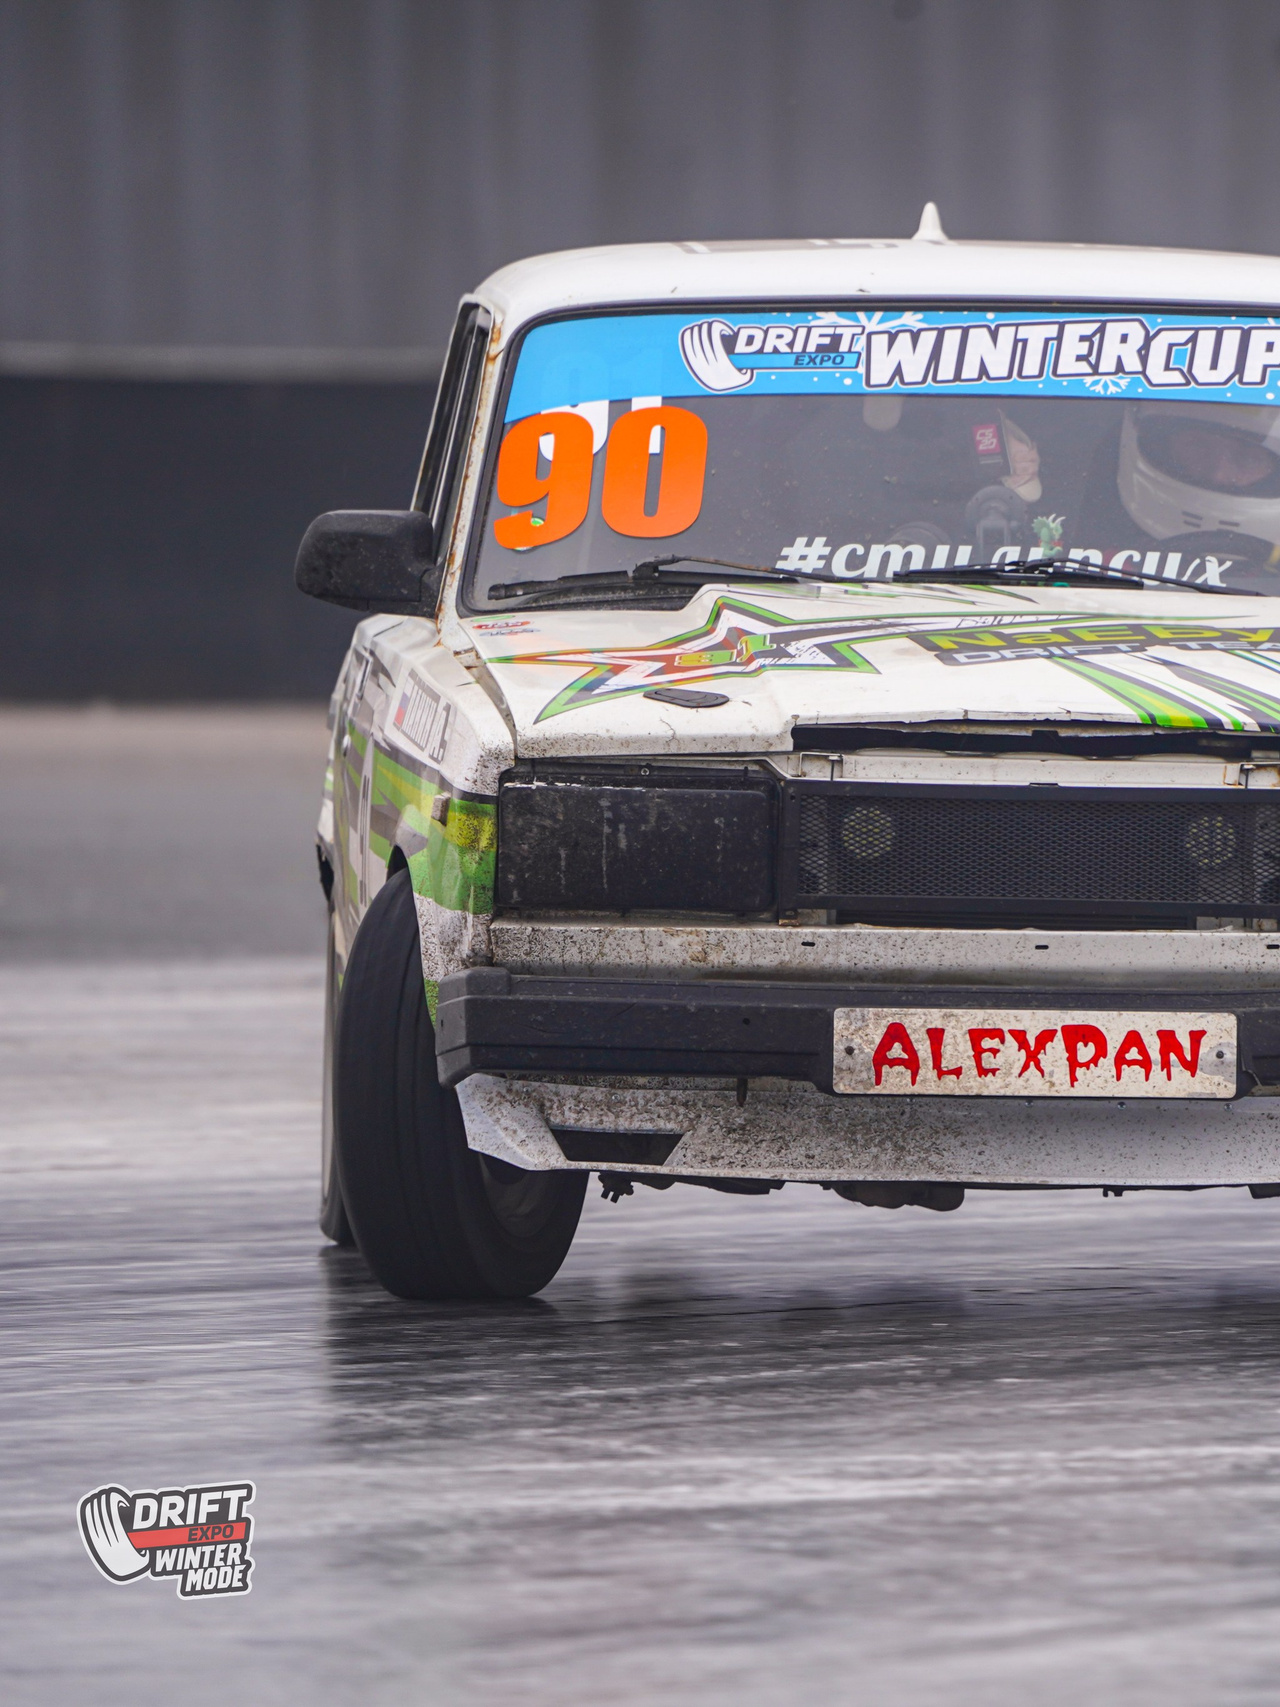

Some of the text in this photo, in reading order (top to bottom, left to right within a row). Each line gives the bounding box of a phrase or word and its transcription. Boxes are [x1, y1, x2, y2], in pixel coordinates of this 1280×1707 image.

[734, 326, 857, 353] DRIFT
[793, 354, 845, 367] EXPO
[493, 405, 708, 550] 90
[952, 643, 1140, 663] DRIFT
[871, 1021, 1208, 1088] ALEXPAN
